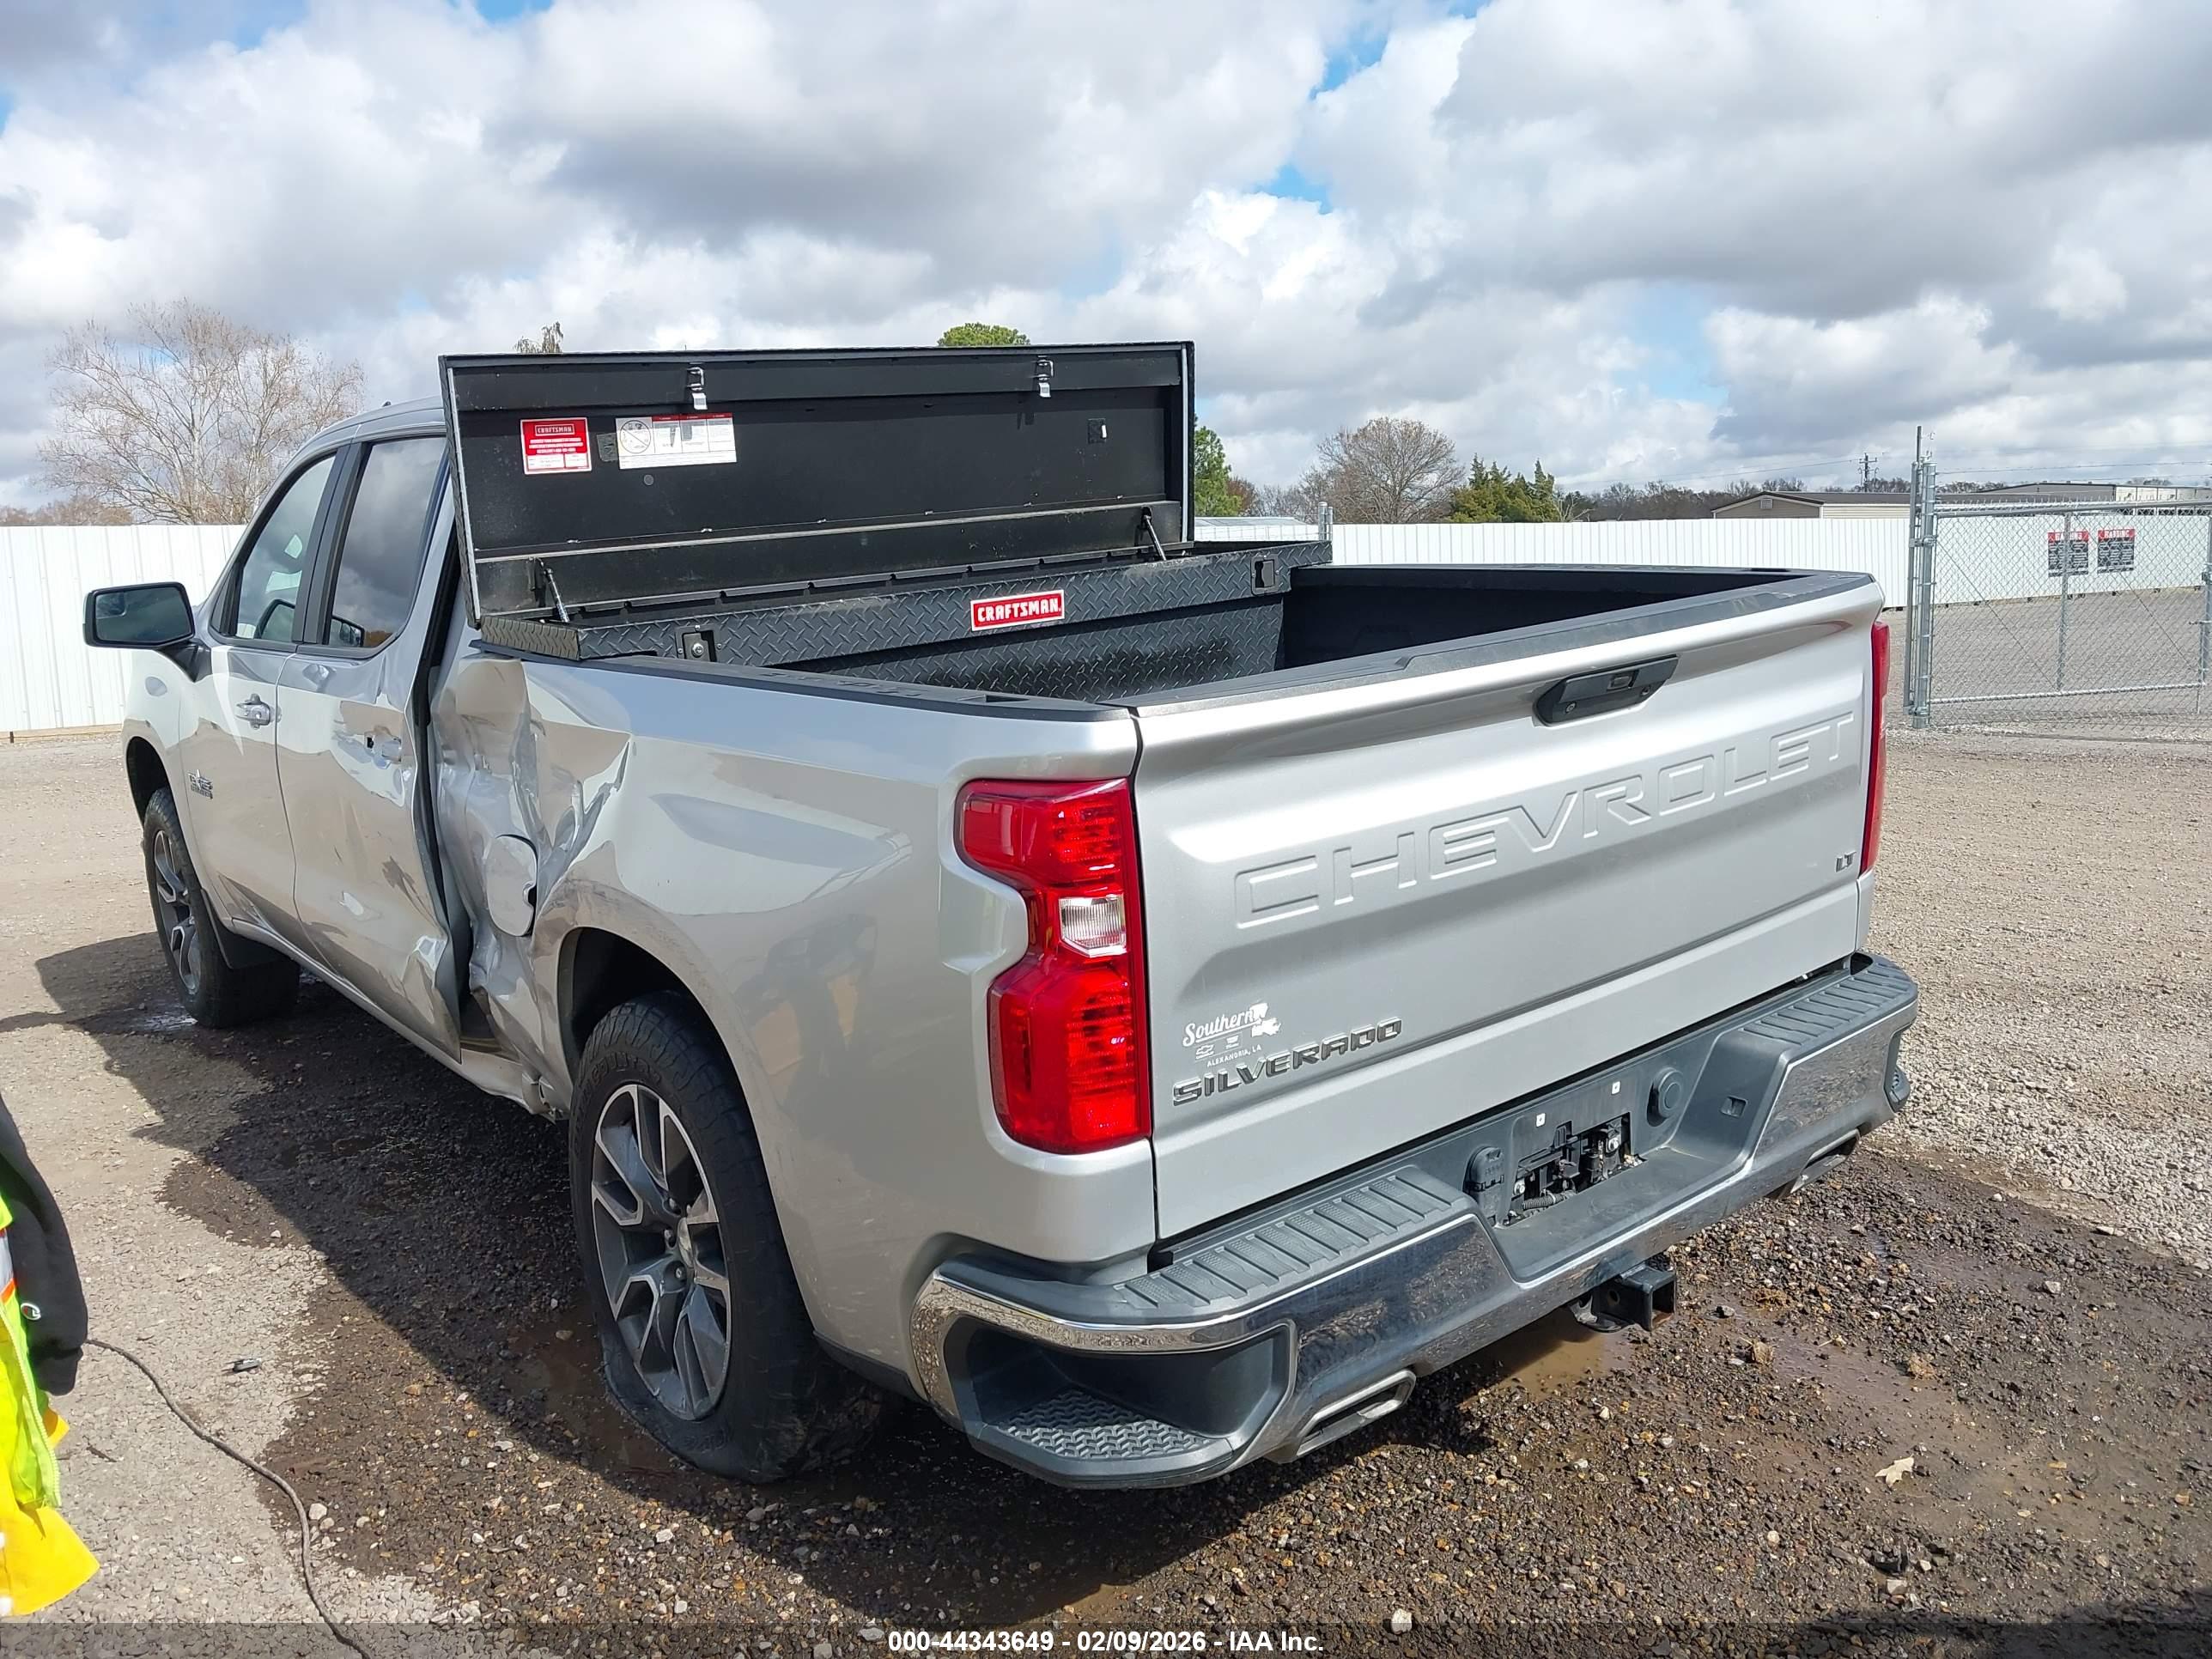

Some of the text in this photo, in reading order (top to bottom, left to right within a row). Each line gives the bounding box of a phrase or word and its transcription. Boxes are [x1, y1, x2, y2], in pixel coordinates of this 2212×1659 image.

[537, 426, 573, 434] CRAFTSMAN
[977, 598, 1059, 623] CRAFTSMAN
[1236, 713, 1855, 930] CHEVROLET
[1835, 850, 1856, 872] LT
[1182, 1010, 1257, 1047] Southern
[1173, 1016, 1403, 1107] SILVERADO
[1252, 1044, 1261, 1054] LA
